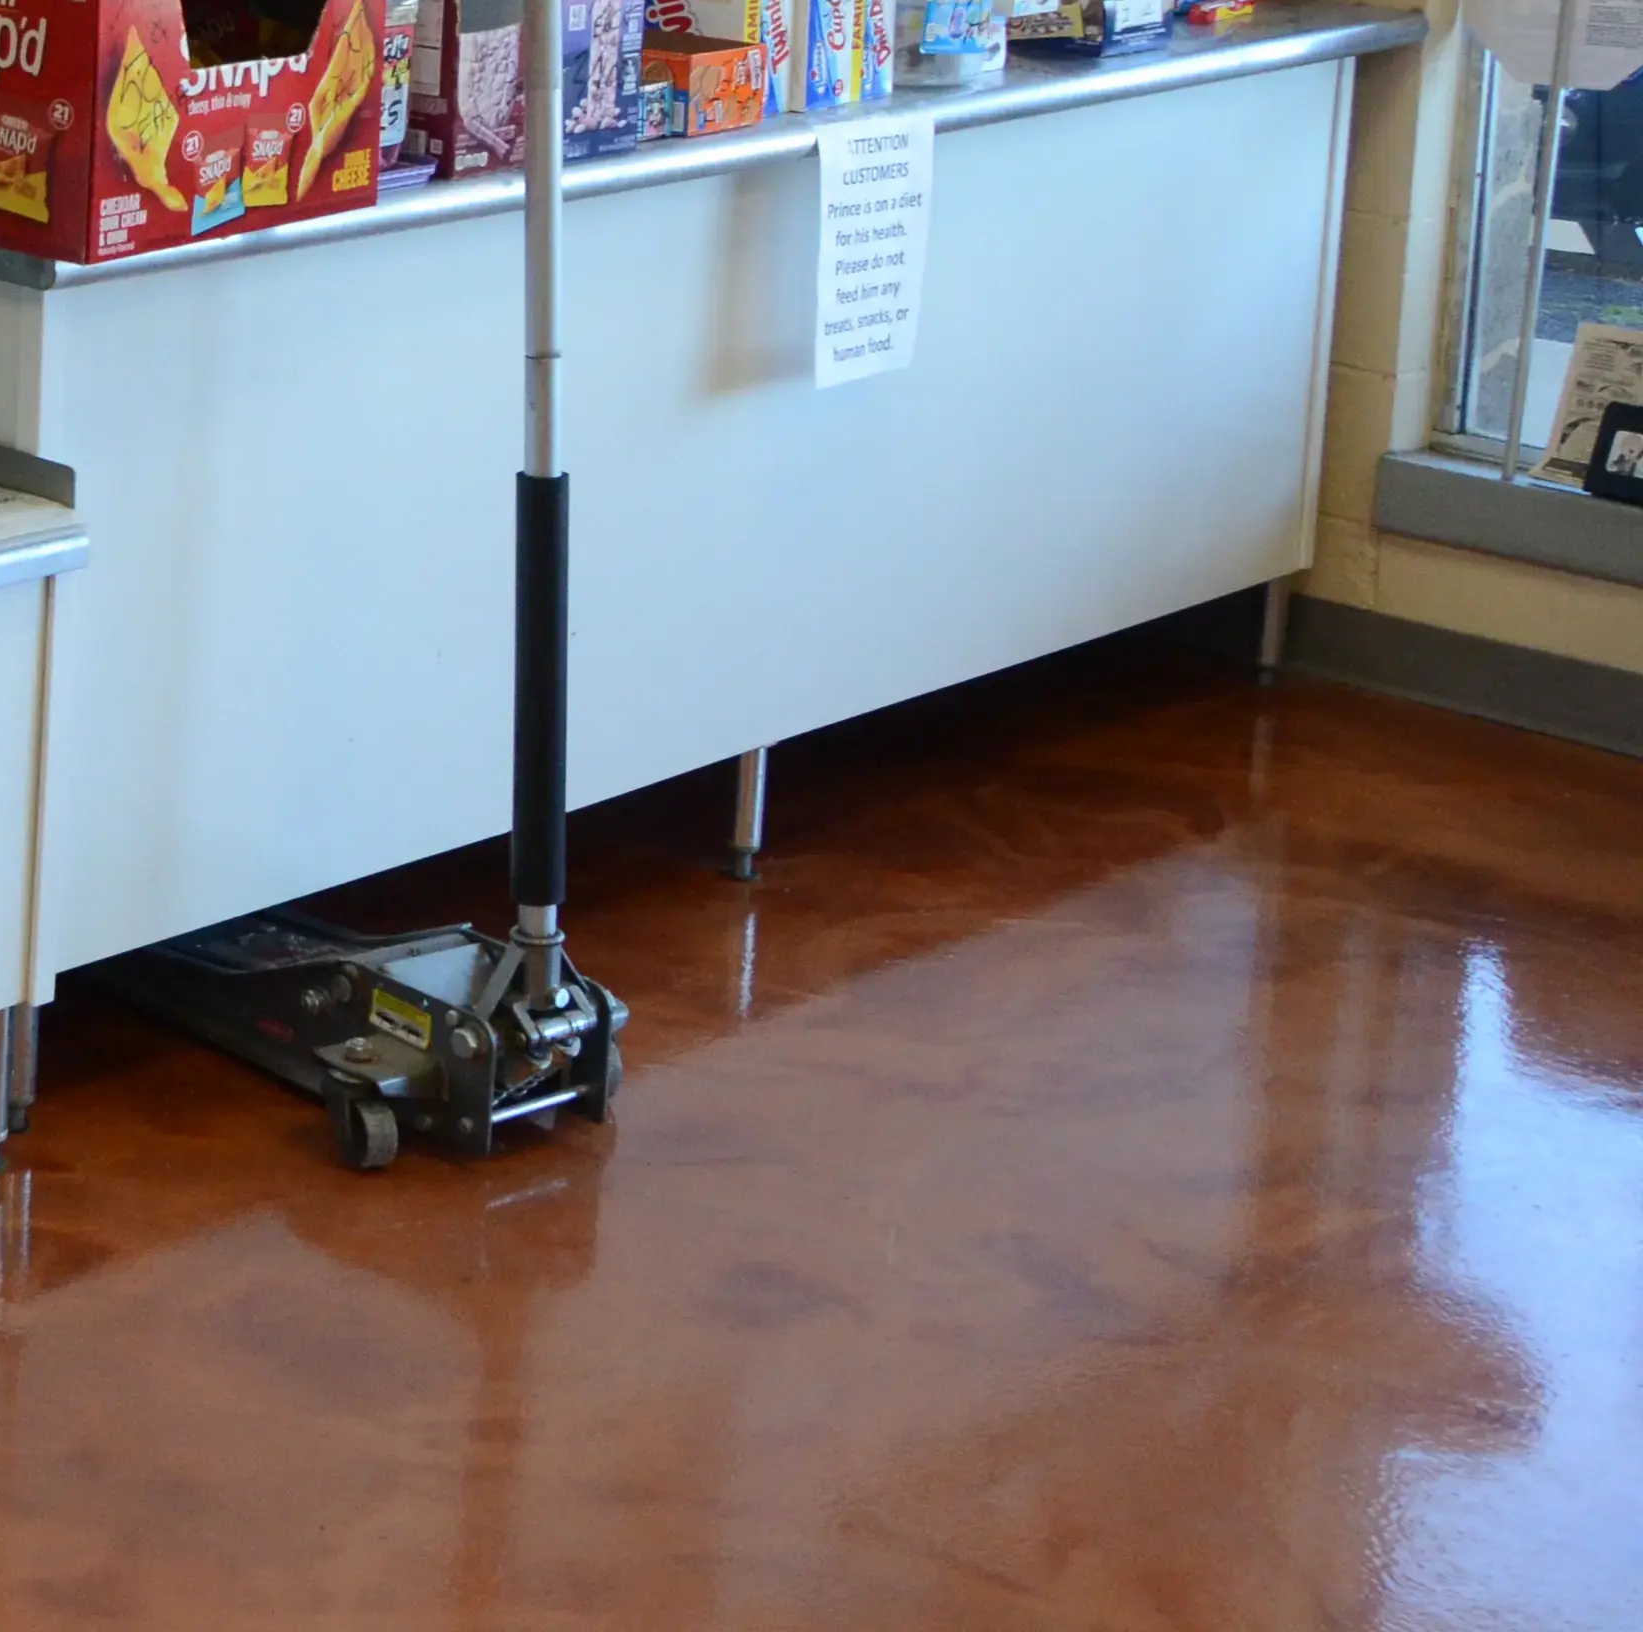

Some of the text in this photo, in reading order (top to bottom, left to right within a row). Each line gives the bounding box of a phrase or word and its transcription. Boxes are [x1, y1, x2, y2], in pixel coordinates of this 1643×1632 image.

[843, 162, 909, 186] CUSTOMERS
[827, 200, 861, 219] Prince
[875, 199, 889, 213] on
[899, 192, 923, 209] diet
[835, 250, 905, 276] Please not
[881, 280, 901, 298] any
